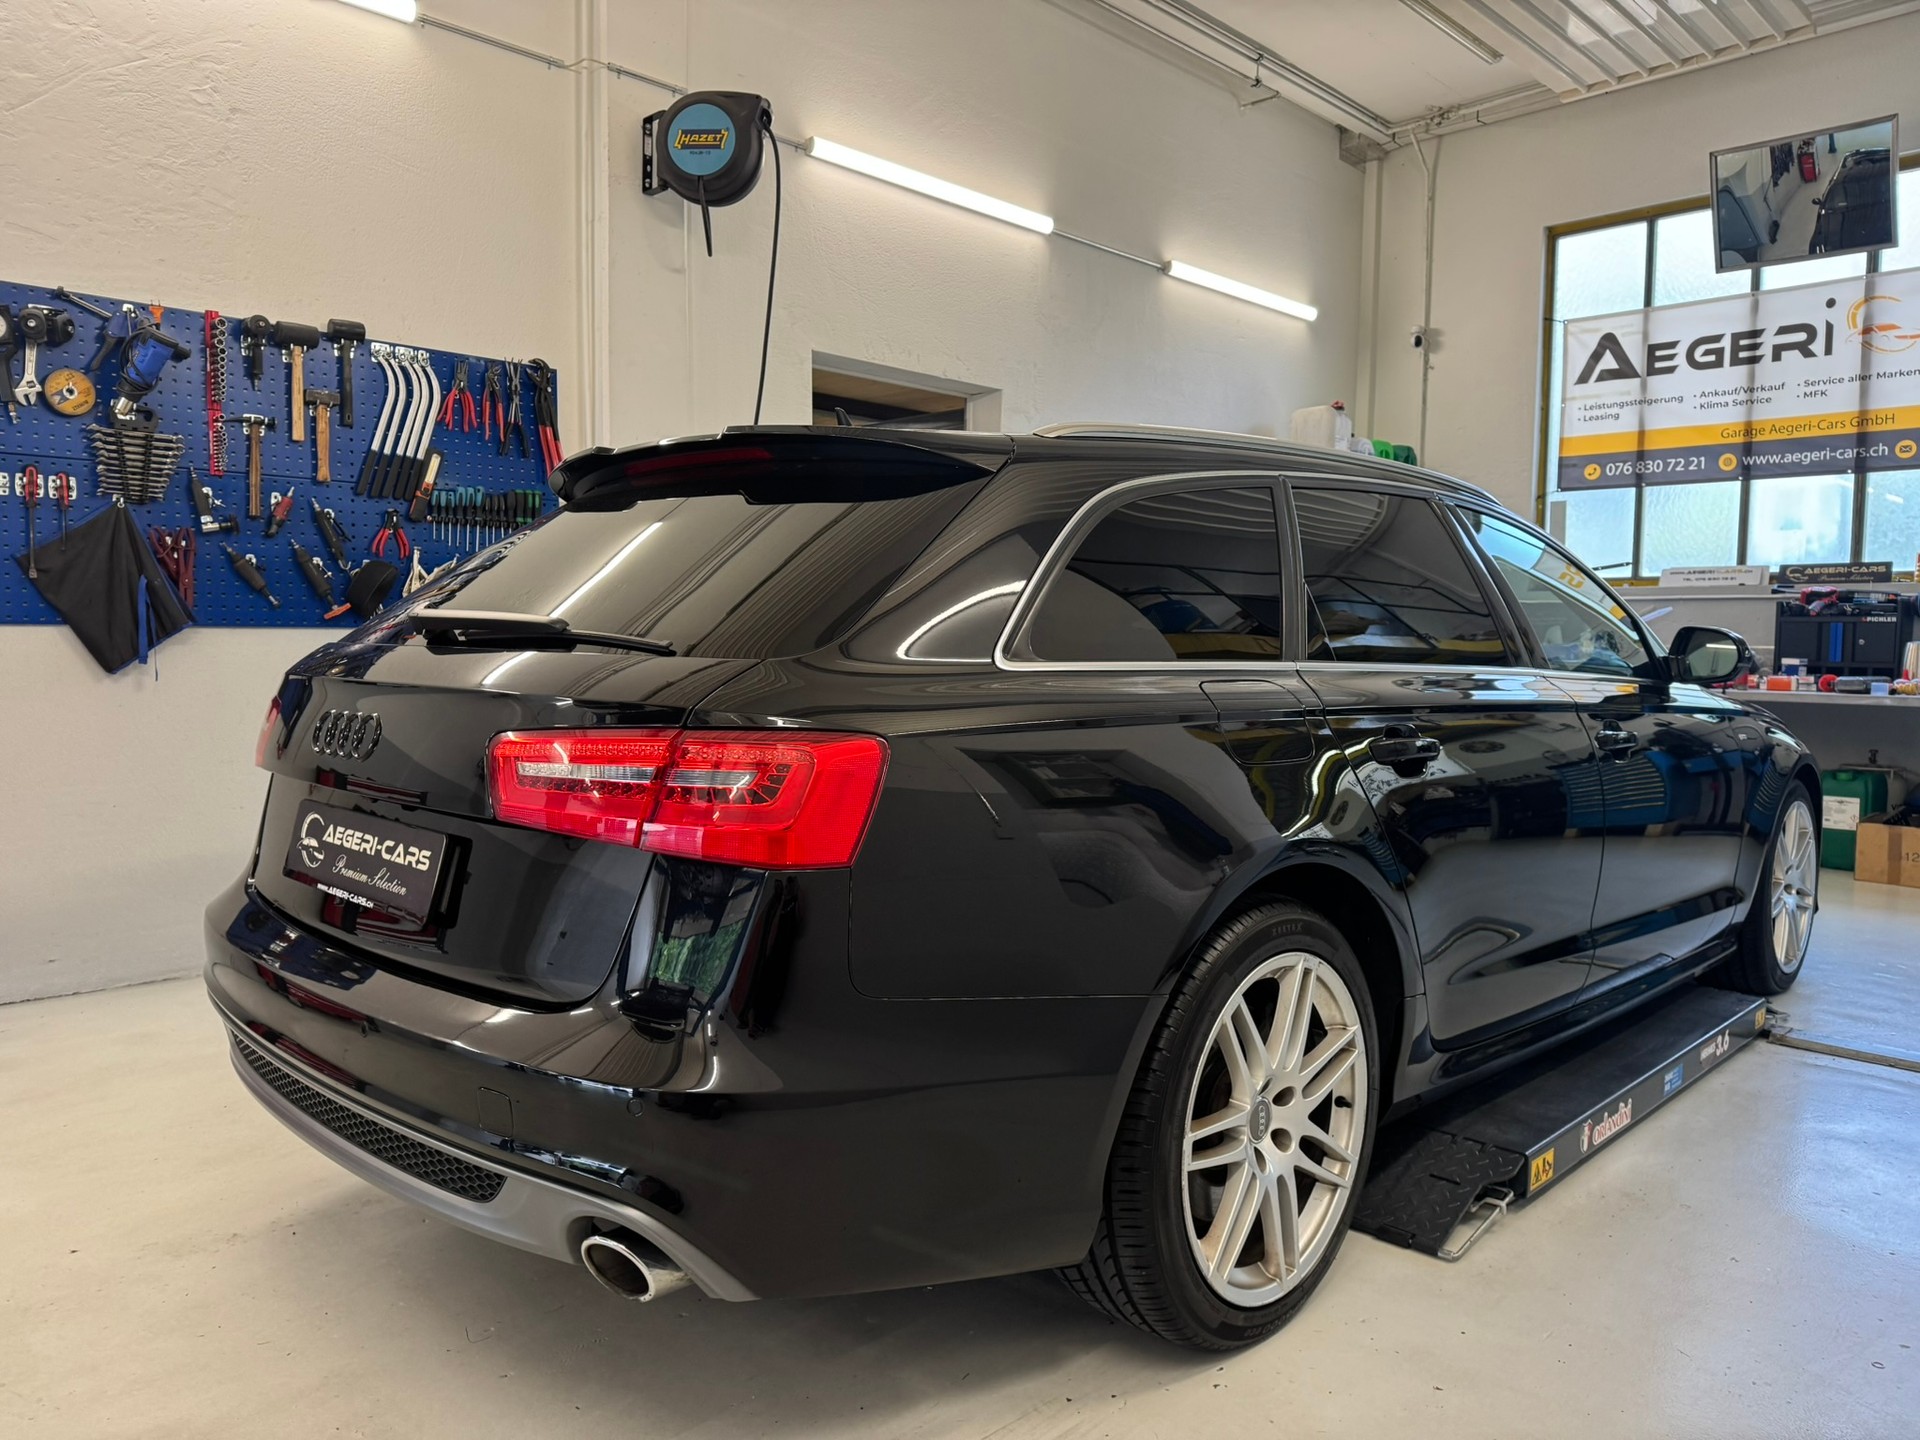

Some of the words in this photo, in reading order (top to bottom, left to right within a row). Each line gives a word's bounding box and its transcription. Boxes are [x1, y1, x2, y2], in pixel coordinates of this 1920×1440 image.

[679, 133, 723, 145] HAZET
[1803, 375, 1845, 389] Service
[1847, 372, 1873, 384] aller
[1876, 367, 1920, 380] Marken
[1698, 382, 1786, 400] Ankauf/Verkauf
[1803, 388, 1829, 399] MFK
[1583, 394, 1684, 412] Leistungssteigerung
[1699, 401, 1730, 411] Klima
[1731, 395, 1772, 408] Service
[1583, 411, 1620, 423] Leasing
[1720, 424, 1767, 440] Garage
[1768, 418, 1847, 436] Aegeri-Cars
[1849, 412, 1896, 428] GmbH
[1742, 442, 1889, 467] www.aegeri-cars.ch
[1605, 462, 1634, 477] 076
[1635, 459, 1664, 474] 830
[1666, 458, 1686, 471] 72
[1688, 456, 1706, 470] 21
[1804, 566, 1886, 574] AEGERI-CARS
[322, 824, 432, 872] AEGERI-CARS
[332, 854, 368, 882] Premium
[368, 867, 407, 895] Selection
[1716, 1029, 1730, 1056] 3.6
